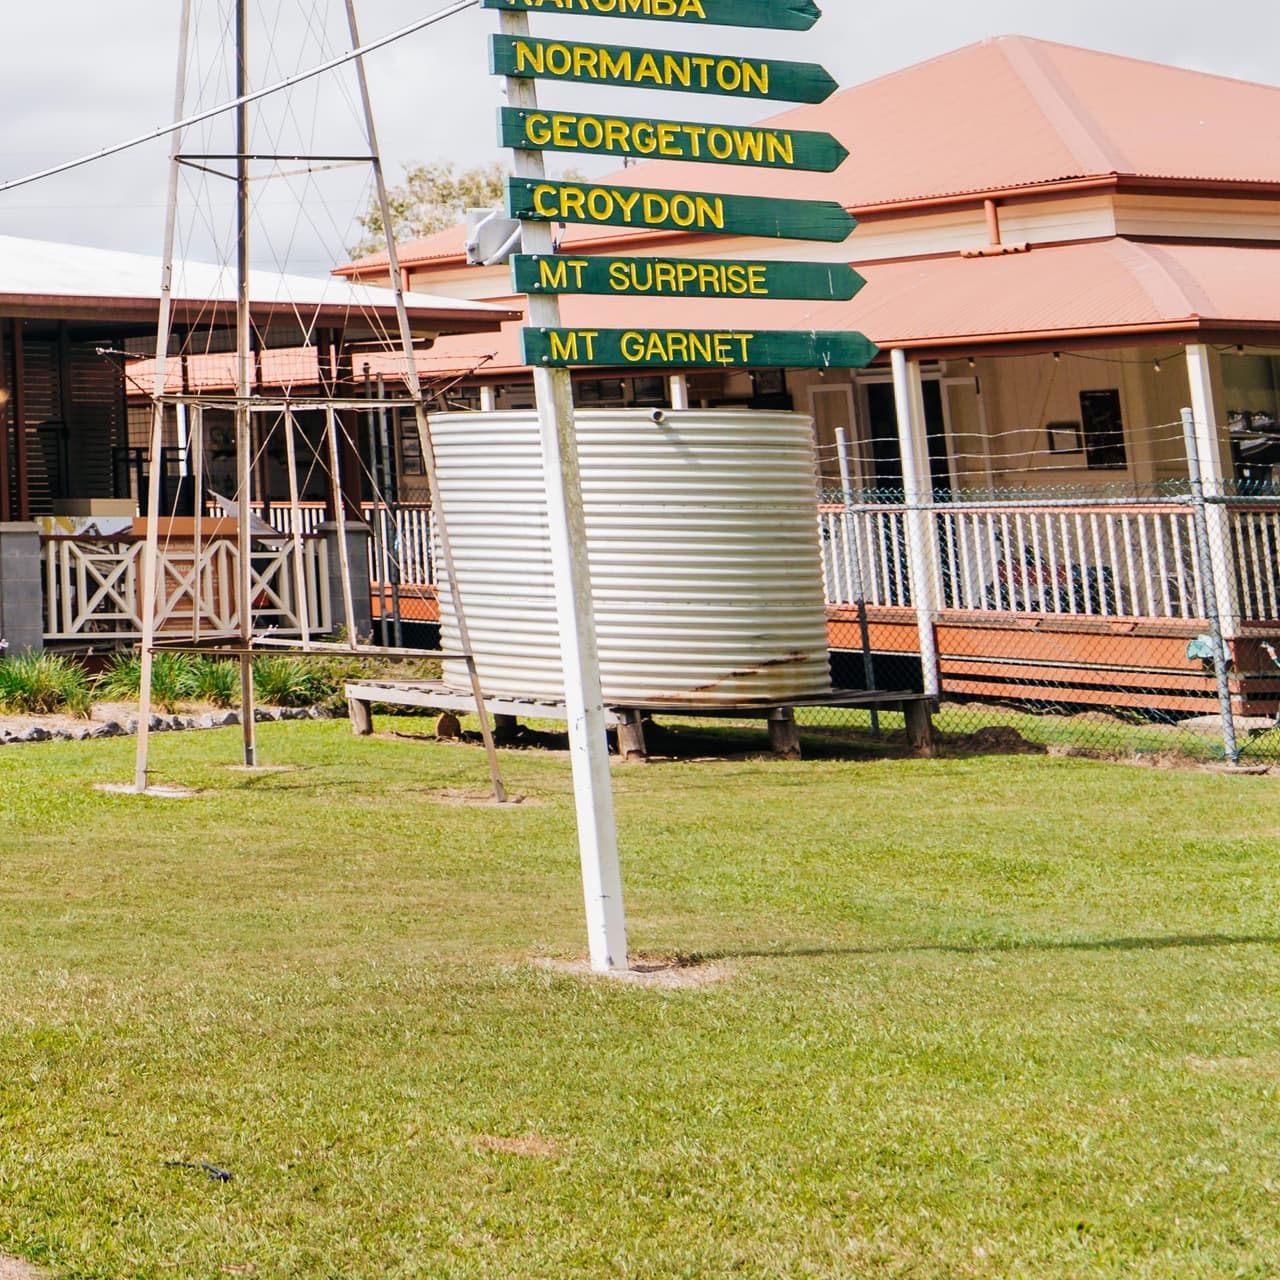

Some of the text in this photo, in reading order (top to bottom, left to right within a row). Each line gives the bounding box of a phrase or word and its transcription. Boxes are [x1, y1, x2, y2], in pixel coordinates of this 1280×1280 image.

[516, 40, 769, 94] NORMANTON
[525, 114, 794, 165] GEORGETOWN
[533, 185, 724, 229] CROYDON
[540, 260, 769, 295] MT SURPRISE
[550, 331, 754, 363] MT GARNET
